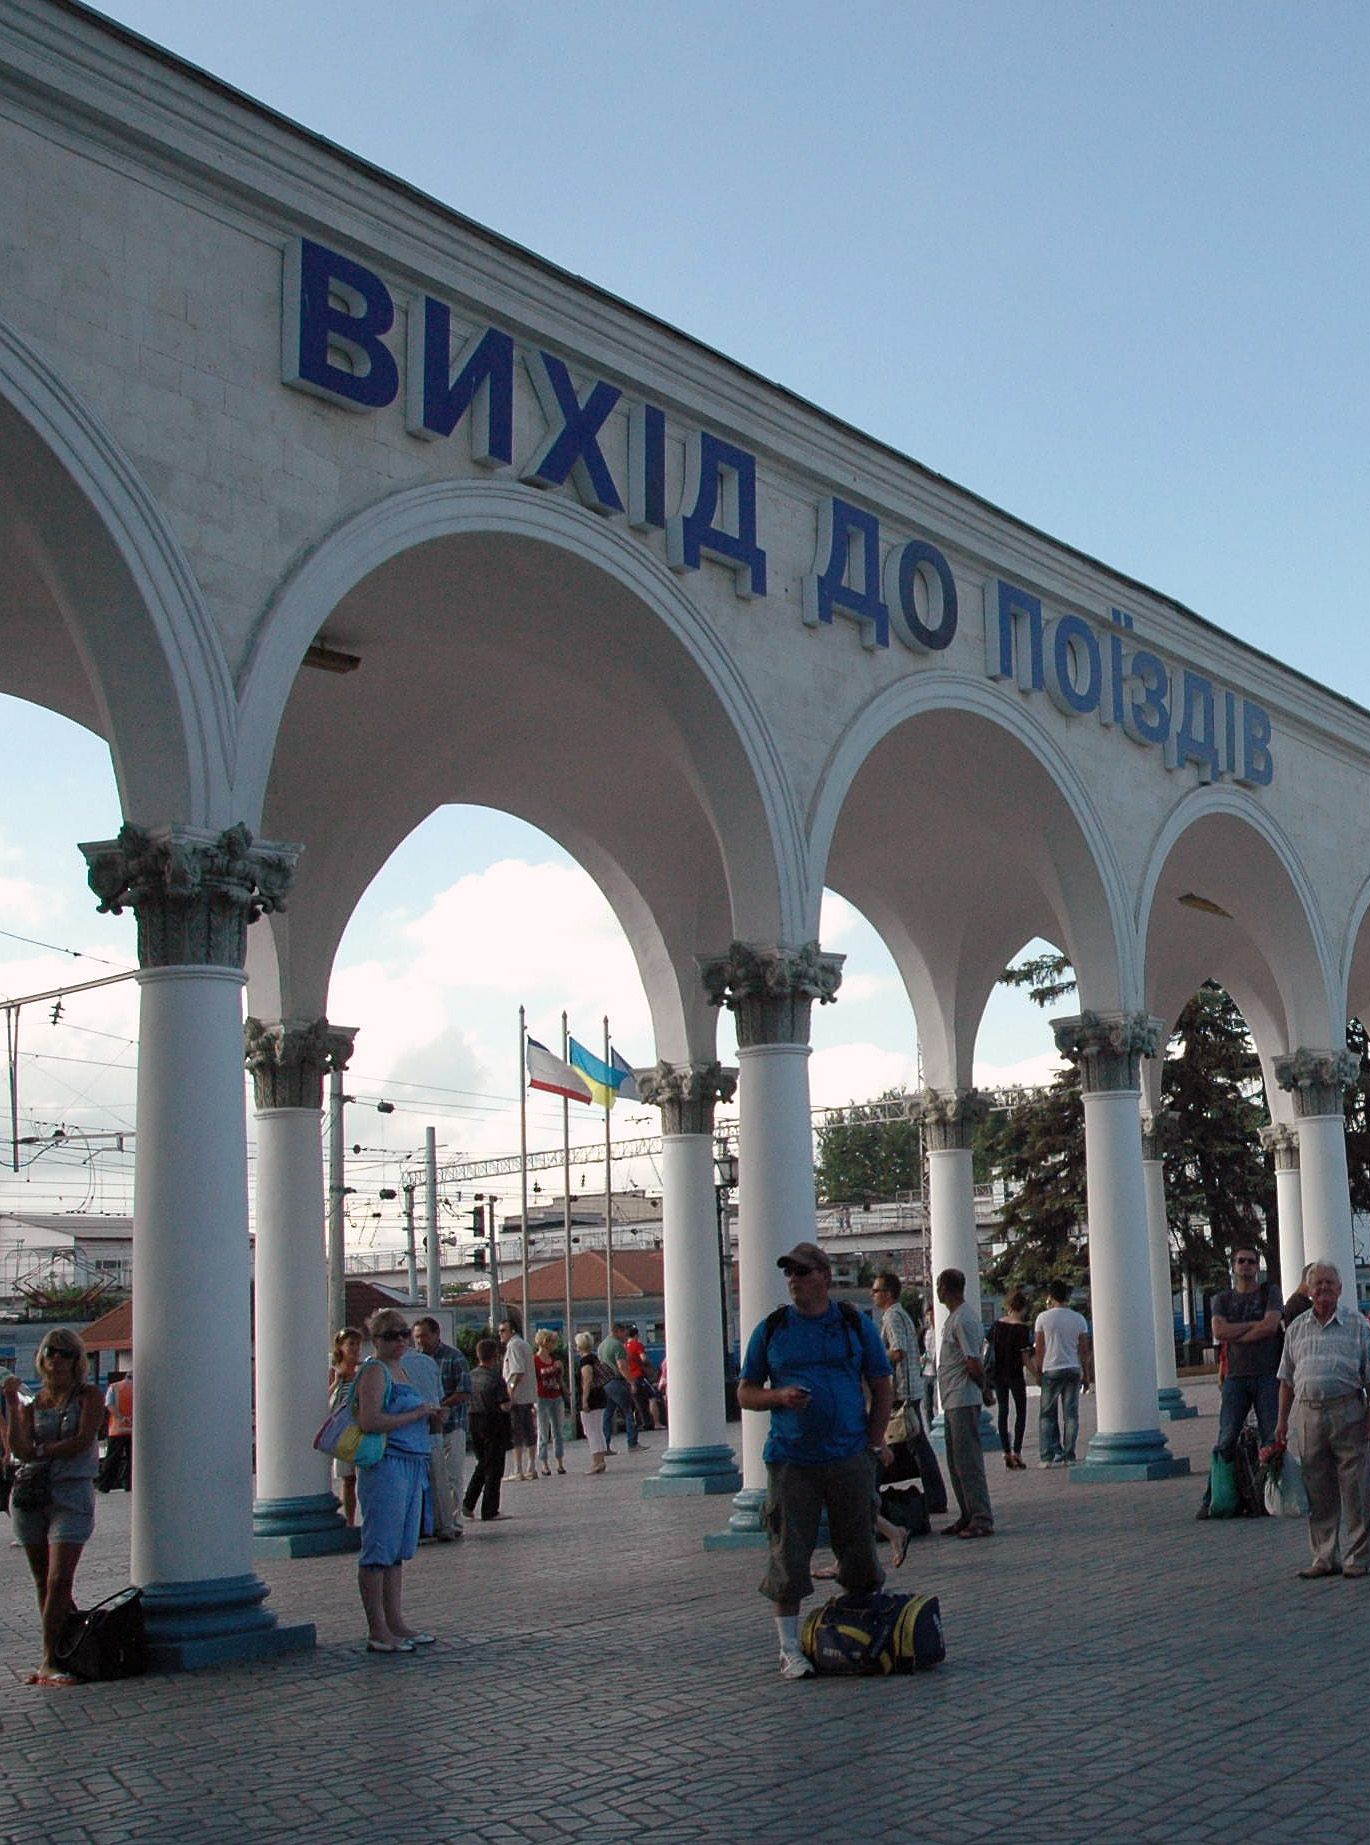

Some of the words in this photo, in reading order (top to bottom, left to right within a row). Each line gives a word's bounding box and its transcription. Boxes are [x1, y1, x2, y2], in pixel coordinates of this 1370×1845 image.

[299, 236, 768, 598] ВИХІД
[816, 496, 958, 651] ДО
[997, 579, 1275, 786] ПОЇЗДІВ
